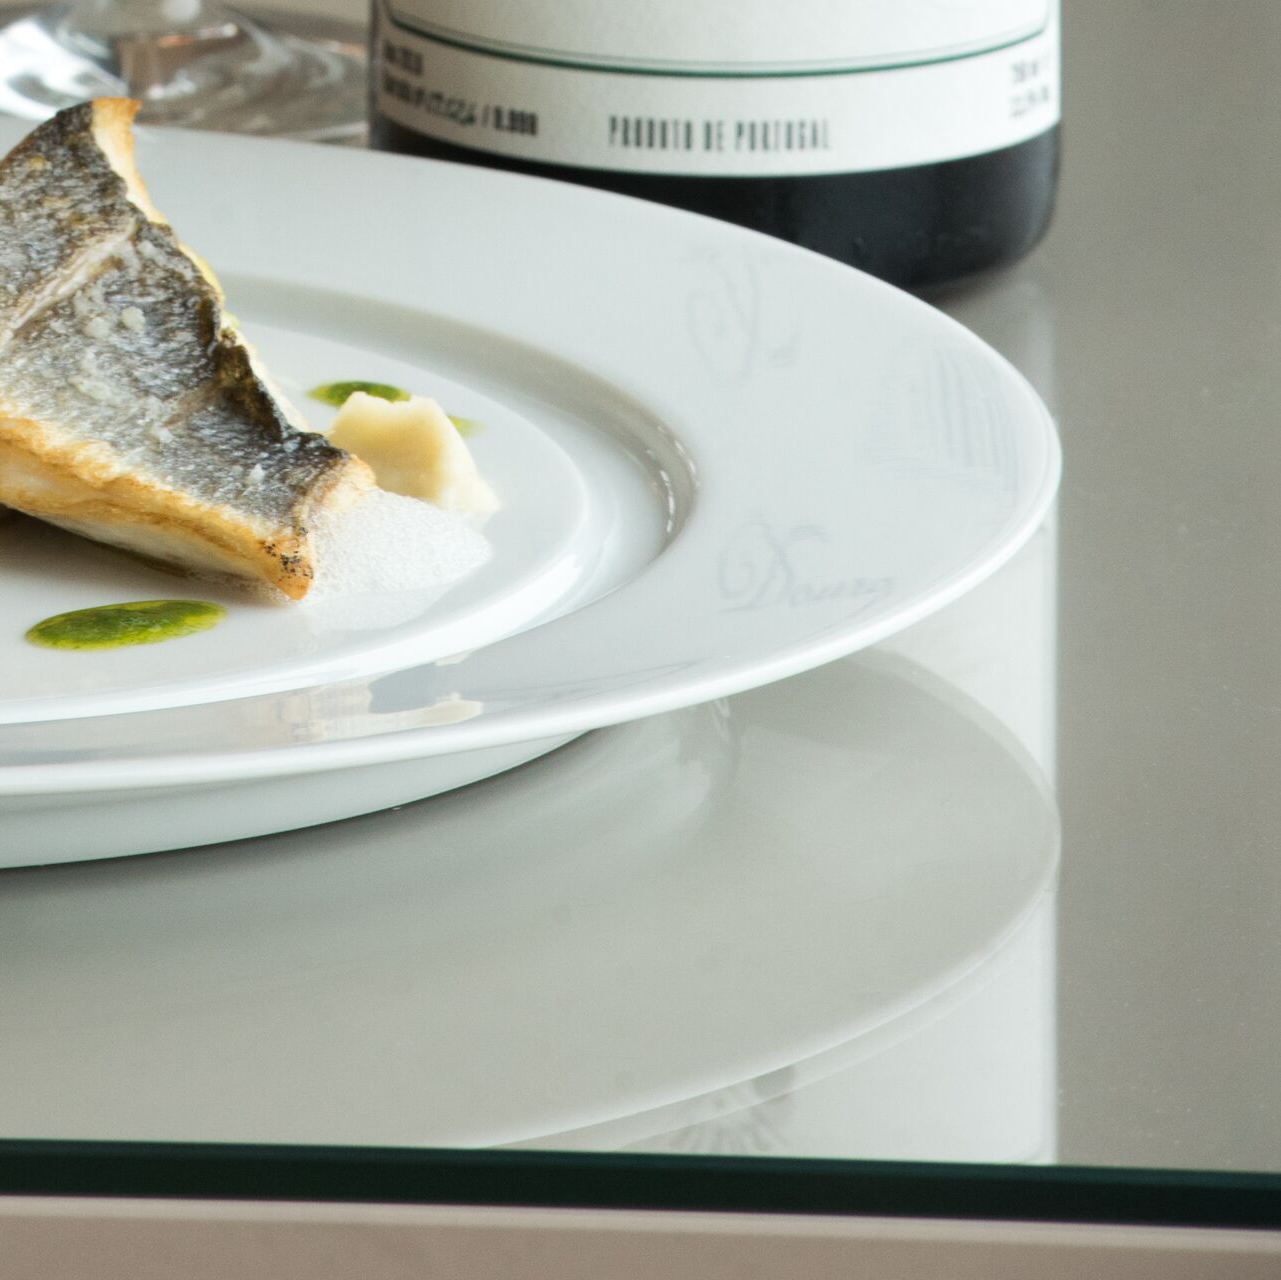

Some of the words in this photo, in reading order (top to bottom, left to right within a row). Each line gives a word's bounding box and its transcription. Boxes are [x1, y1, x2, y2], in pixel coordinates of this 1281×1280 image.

[609, 115, 693, 150] PRODUTO
[704, 120, 725, 151] DE
[735, 118, 830, 151] PORTUGAL
